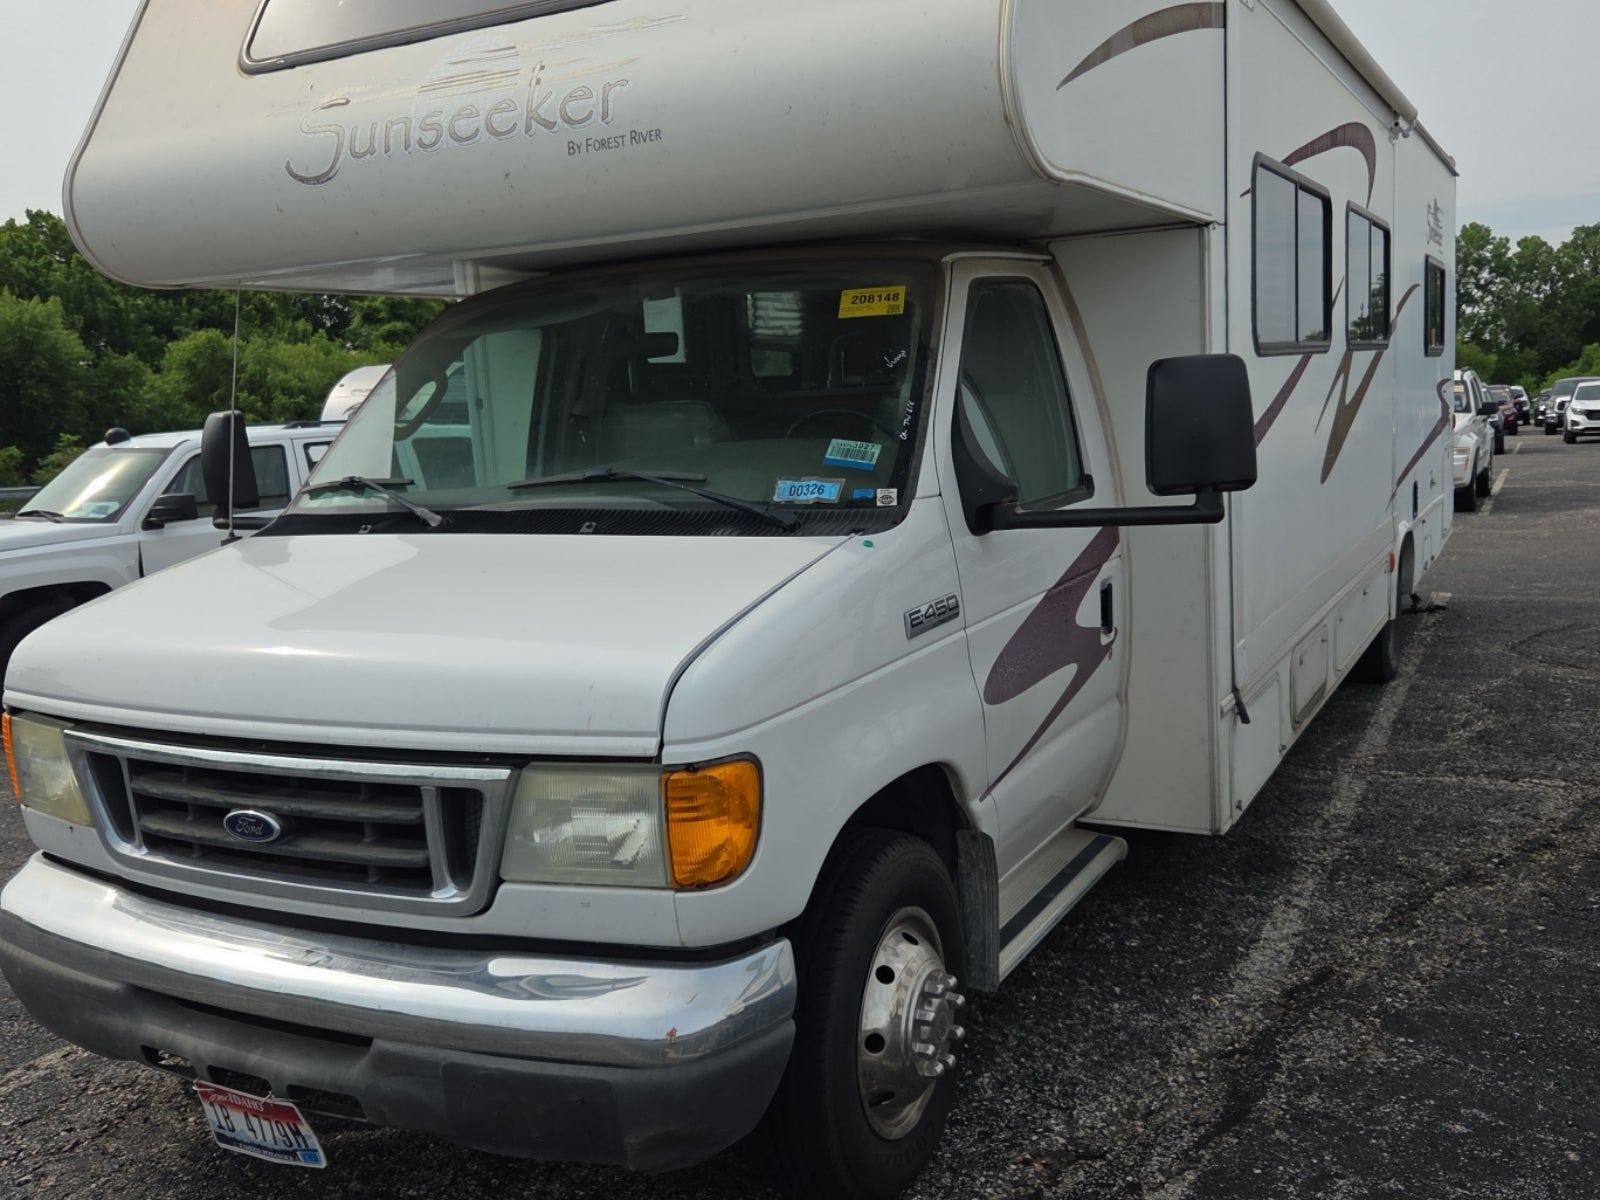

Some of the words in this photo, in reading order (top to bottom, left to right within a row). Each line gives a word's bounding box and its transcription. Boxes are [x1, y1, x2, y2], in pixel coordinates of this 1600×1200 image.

[285, 60, 629, 186] Sunseeker
[585, 134, 626, 153] FOREST
[629, 128, 662, 146] RIVER
[850, 292, 900, 305] 208148
[788, 483, 826, 497] 00326
[235, 816, 264, 836] Ford
[227, 1092, 265, 1112] IDAHO
